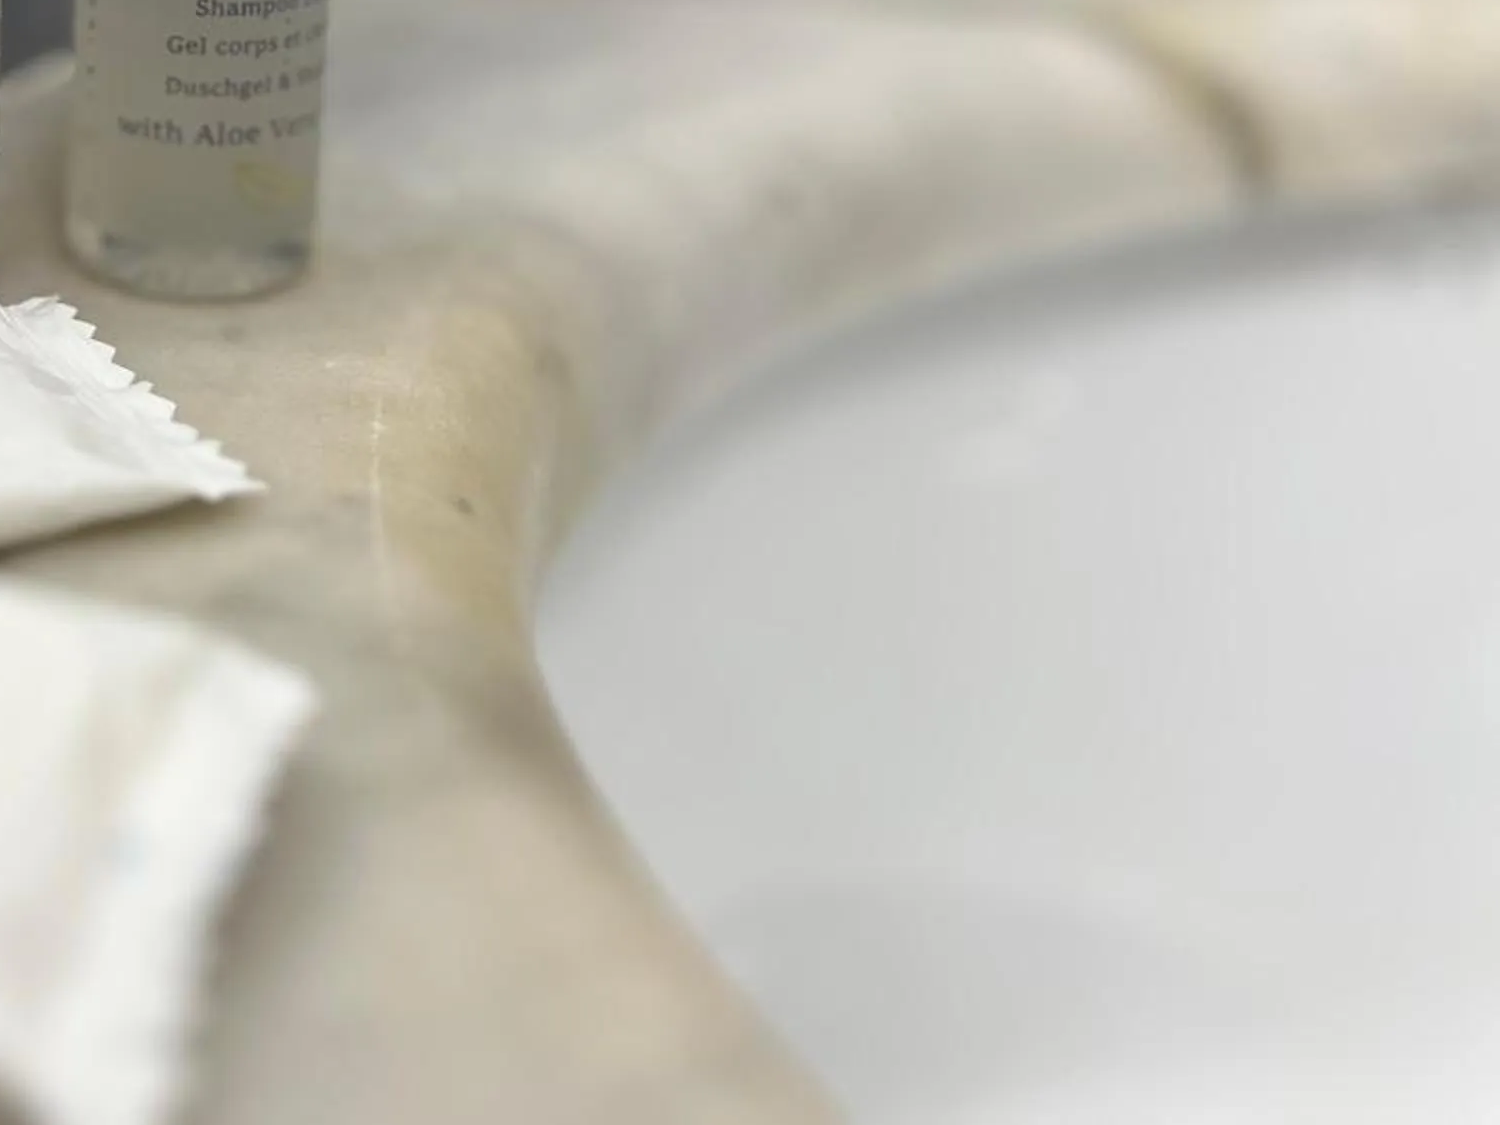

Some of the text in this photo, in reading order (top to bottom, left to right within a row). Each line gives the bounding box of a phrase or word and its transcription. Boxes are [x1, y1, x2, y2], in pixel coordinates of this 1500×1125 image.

[165, 35, 207, 56] Gel
[214, 38, 278, 59] corps
[164, 74, 272, 101] Duschgel
[117, 114, 183, 147] with
[193, 121, 261, 148] Aloe
